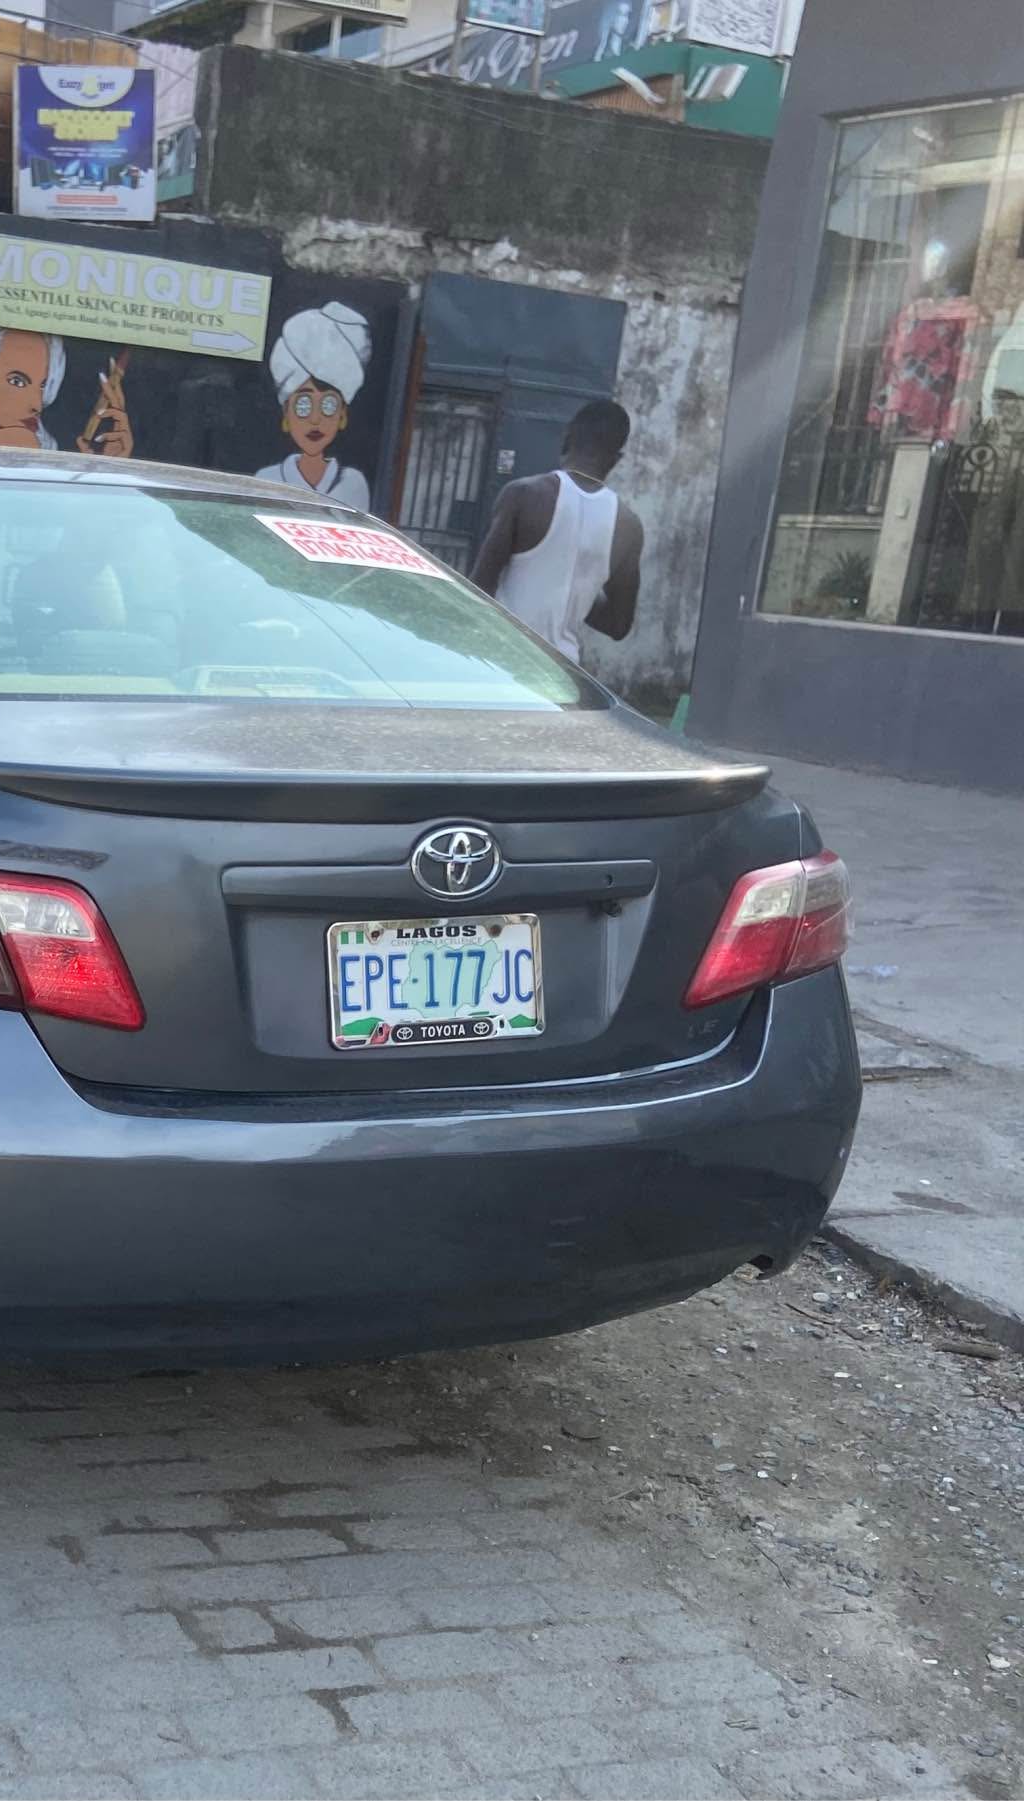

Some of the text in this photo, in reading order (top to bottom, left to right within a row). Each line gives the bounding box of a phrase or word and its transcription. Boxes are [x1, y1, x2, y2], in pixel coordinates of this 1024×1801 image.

[76, 295, 148, 318] SKINCARE
[150, 306, 225, 328] PRODUCTS
[396, 924, 477, 939] LAGOS
[420, 1023, 466, 1038] TOYOTA
